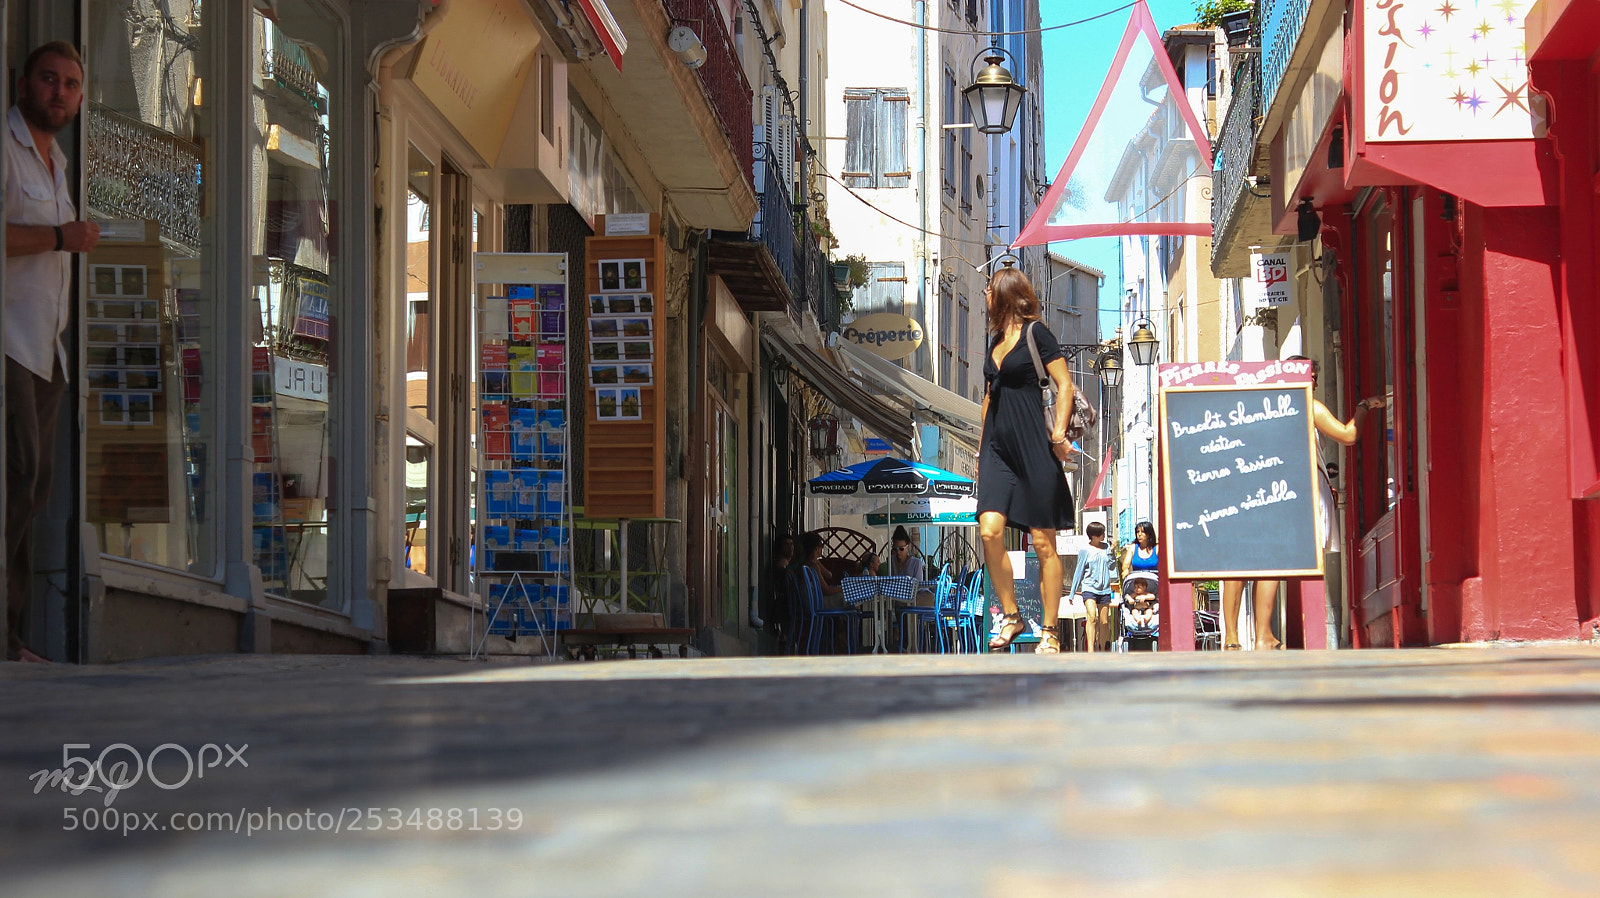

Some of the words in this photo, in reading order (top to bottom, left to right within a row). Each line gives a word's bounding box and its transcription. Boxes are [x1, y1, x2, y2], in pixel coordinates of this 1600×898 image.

[1376, 0, 1416, 137] sion
[1257, 258, 1286, 266] CANAL
[843, 324, 922, 347] Crêperie
[1171, 410, 1227, 438] Bracelets
[1228, 394, 1300, 426] Shamballa
[1200, 435, 1246, 454] création
[1187, 467, 1231, 485] Pierres
[1235, 455, 1284, 474] Passion
[936, 484, 972, 492] POWERADE
[1176, 521, 1194, 530] en
[1198, 505, 1239, 537] pierres
